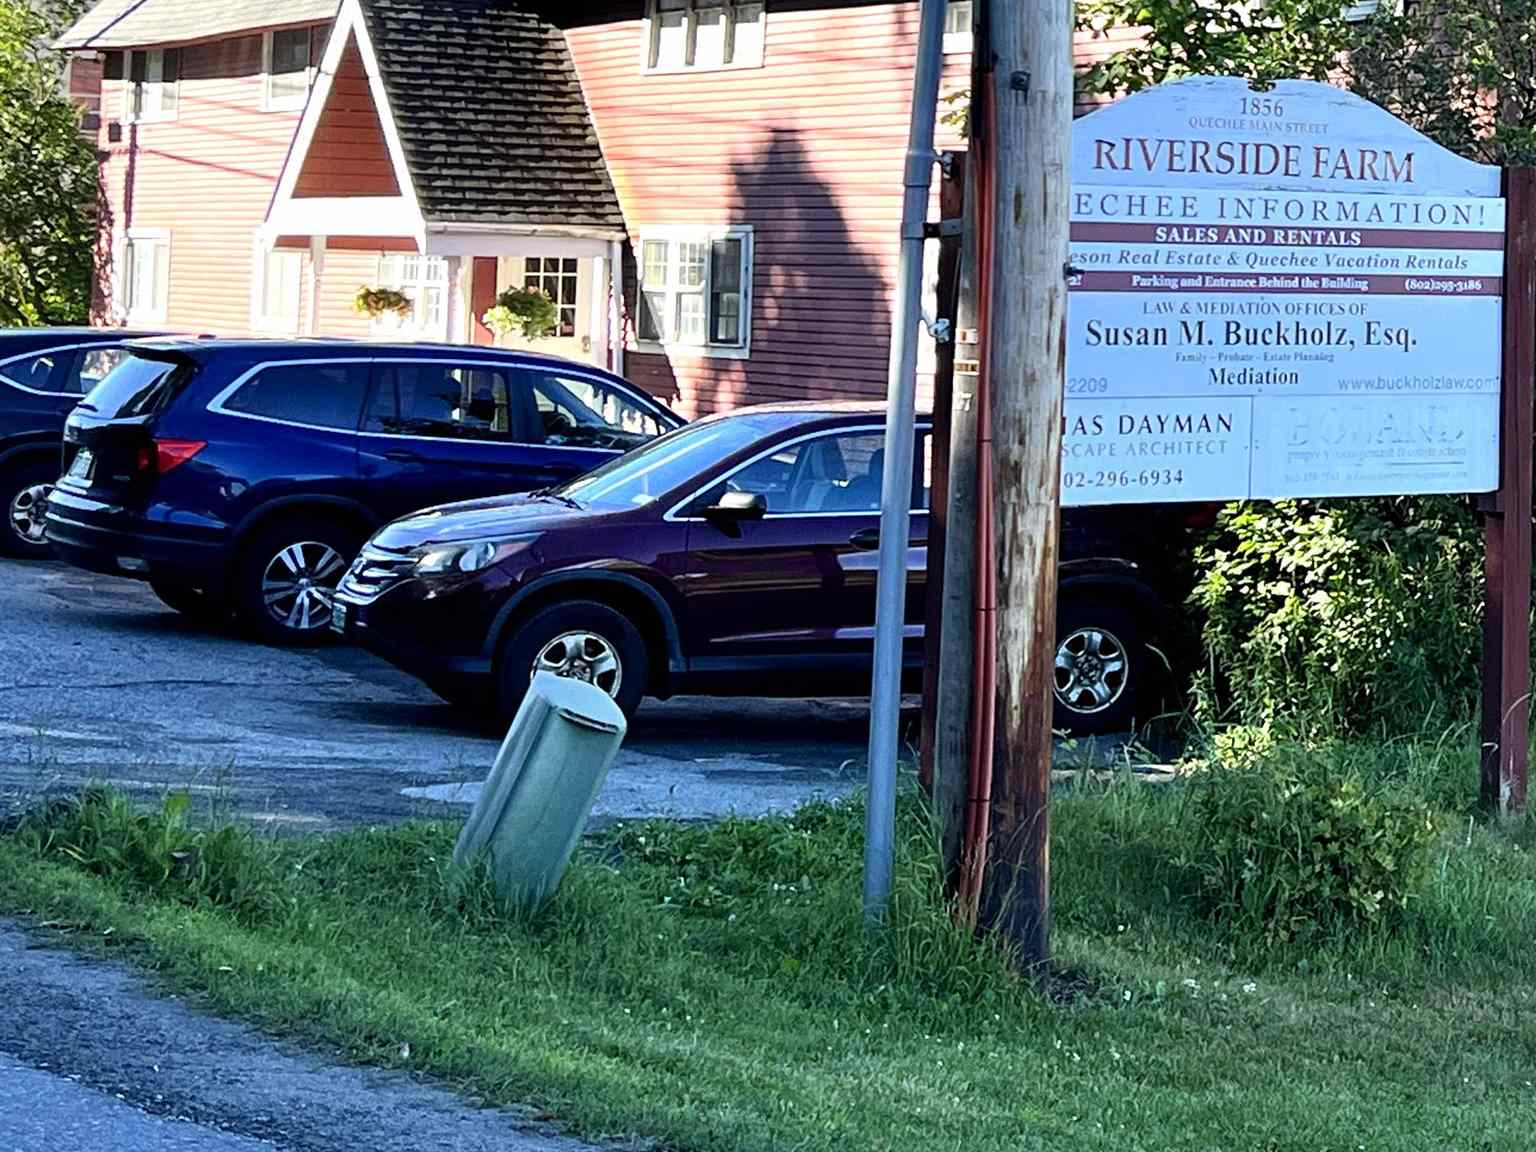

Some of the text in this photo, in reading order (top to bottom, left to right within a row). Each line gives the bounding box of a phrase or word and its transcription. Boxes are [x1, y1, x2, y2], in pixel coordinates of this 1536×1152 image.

[1240, 97, 1284, 117] 1856
[1188, 116, 1329, 135] QUECHEE MAIN STREET
[1092, 137, 1415, 183] RIVERSIDE FARM
[1218, 197, 1485, 225] INFORMATION!
[1155, 226, 1361, 246] SALES AND RENTALS
[1118, 249, 1159, 264] Real
[1165, 250, 1222, 266] Estate
[1226, 251, 1240, 266] &
[1246, 251, 1319, 268] Quechee
[1325, 254, 1400, 268] Vacation
[1405, 255, 1469, 270] Rentals
[1132, 275, 1179, 289] Parking
[1181, 275, 1202, 287] and
[1205, 276, 1256, 287] Entrance
[1259, 275, 1299, 288] Behind
[1301, 276, 1317, 289] the
[1321, 276, 1368, 291] Building
[1143, 302, 1368, 316] LAW & MEDIATION OFFICES OF
[1086, 319, 1417, 353] Susan M. Buckholz, Esq.
[1175, 352, 1207, 364] Family
[1217, 352, 1253, 362] Probate
[1263, 352, 1291, 362] Estate
[1293, 352, 1335, 363] Planning
[1207, 367, 1299, 385] Mediation
[1338, 375, 1496, 392] www.buckholzlaw.com
[1118, 413, 1233, 436] DAYMAN
[1125, 439, 1228, 457] ARCHITECT
